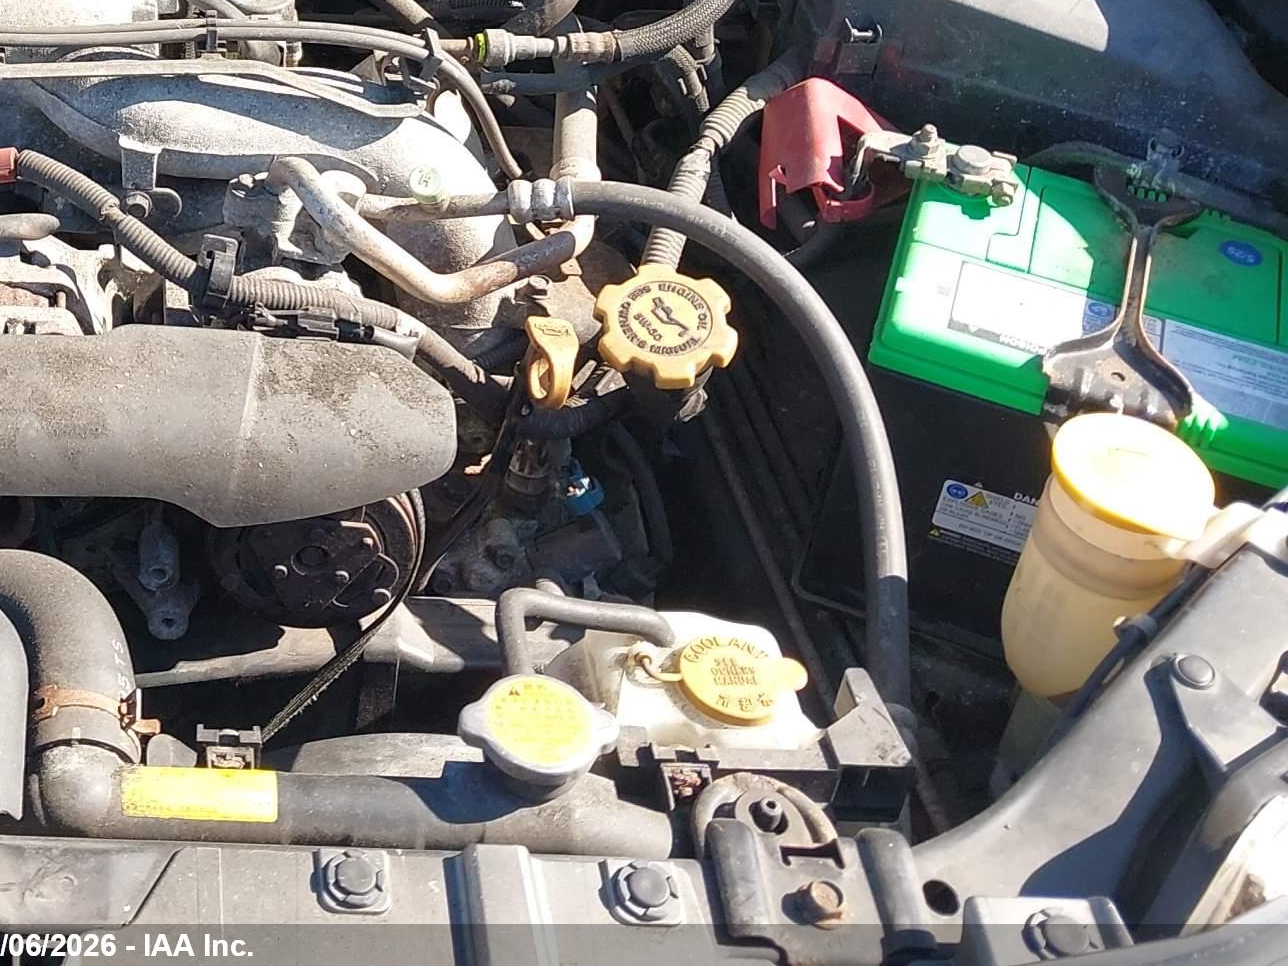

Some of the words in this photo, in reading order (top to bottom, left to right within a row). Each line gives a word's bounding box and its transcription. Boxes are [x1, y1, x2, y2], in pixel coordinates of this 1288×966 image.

[627, 285, 652, 301] SEE
[649, 336, 702, 355] MANUAL
[657, 282, 705, 311] ENGINE
[696, 312, 708, 331] OIL
